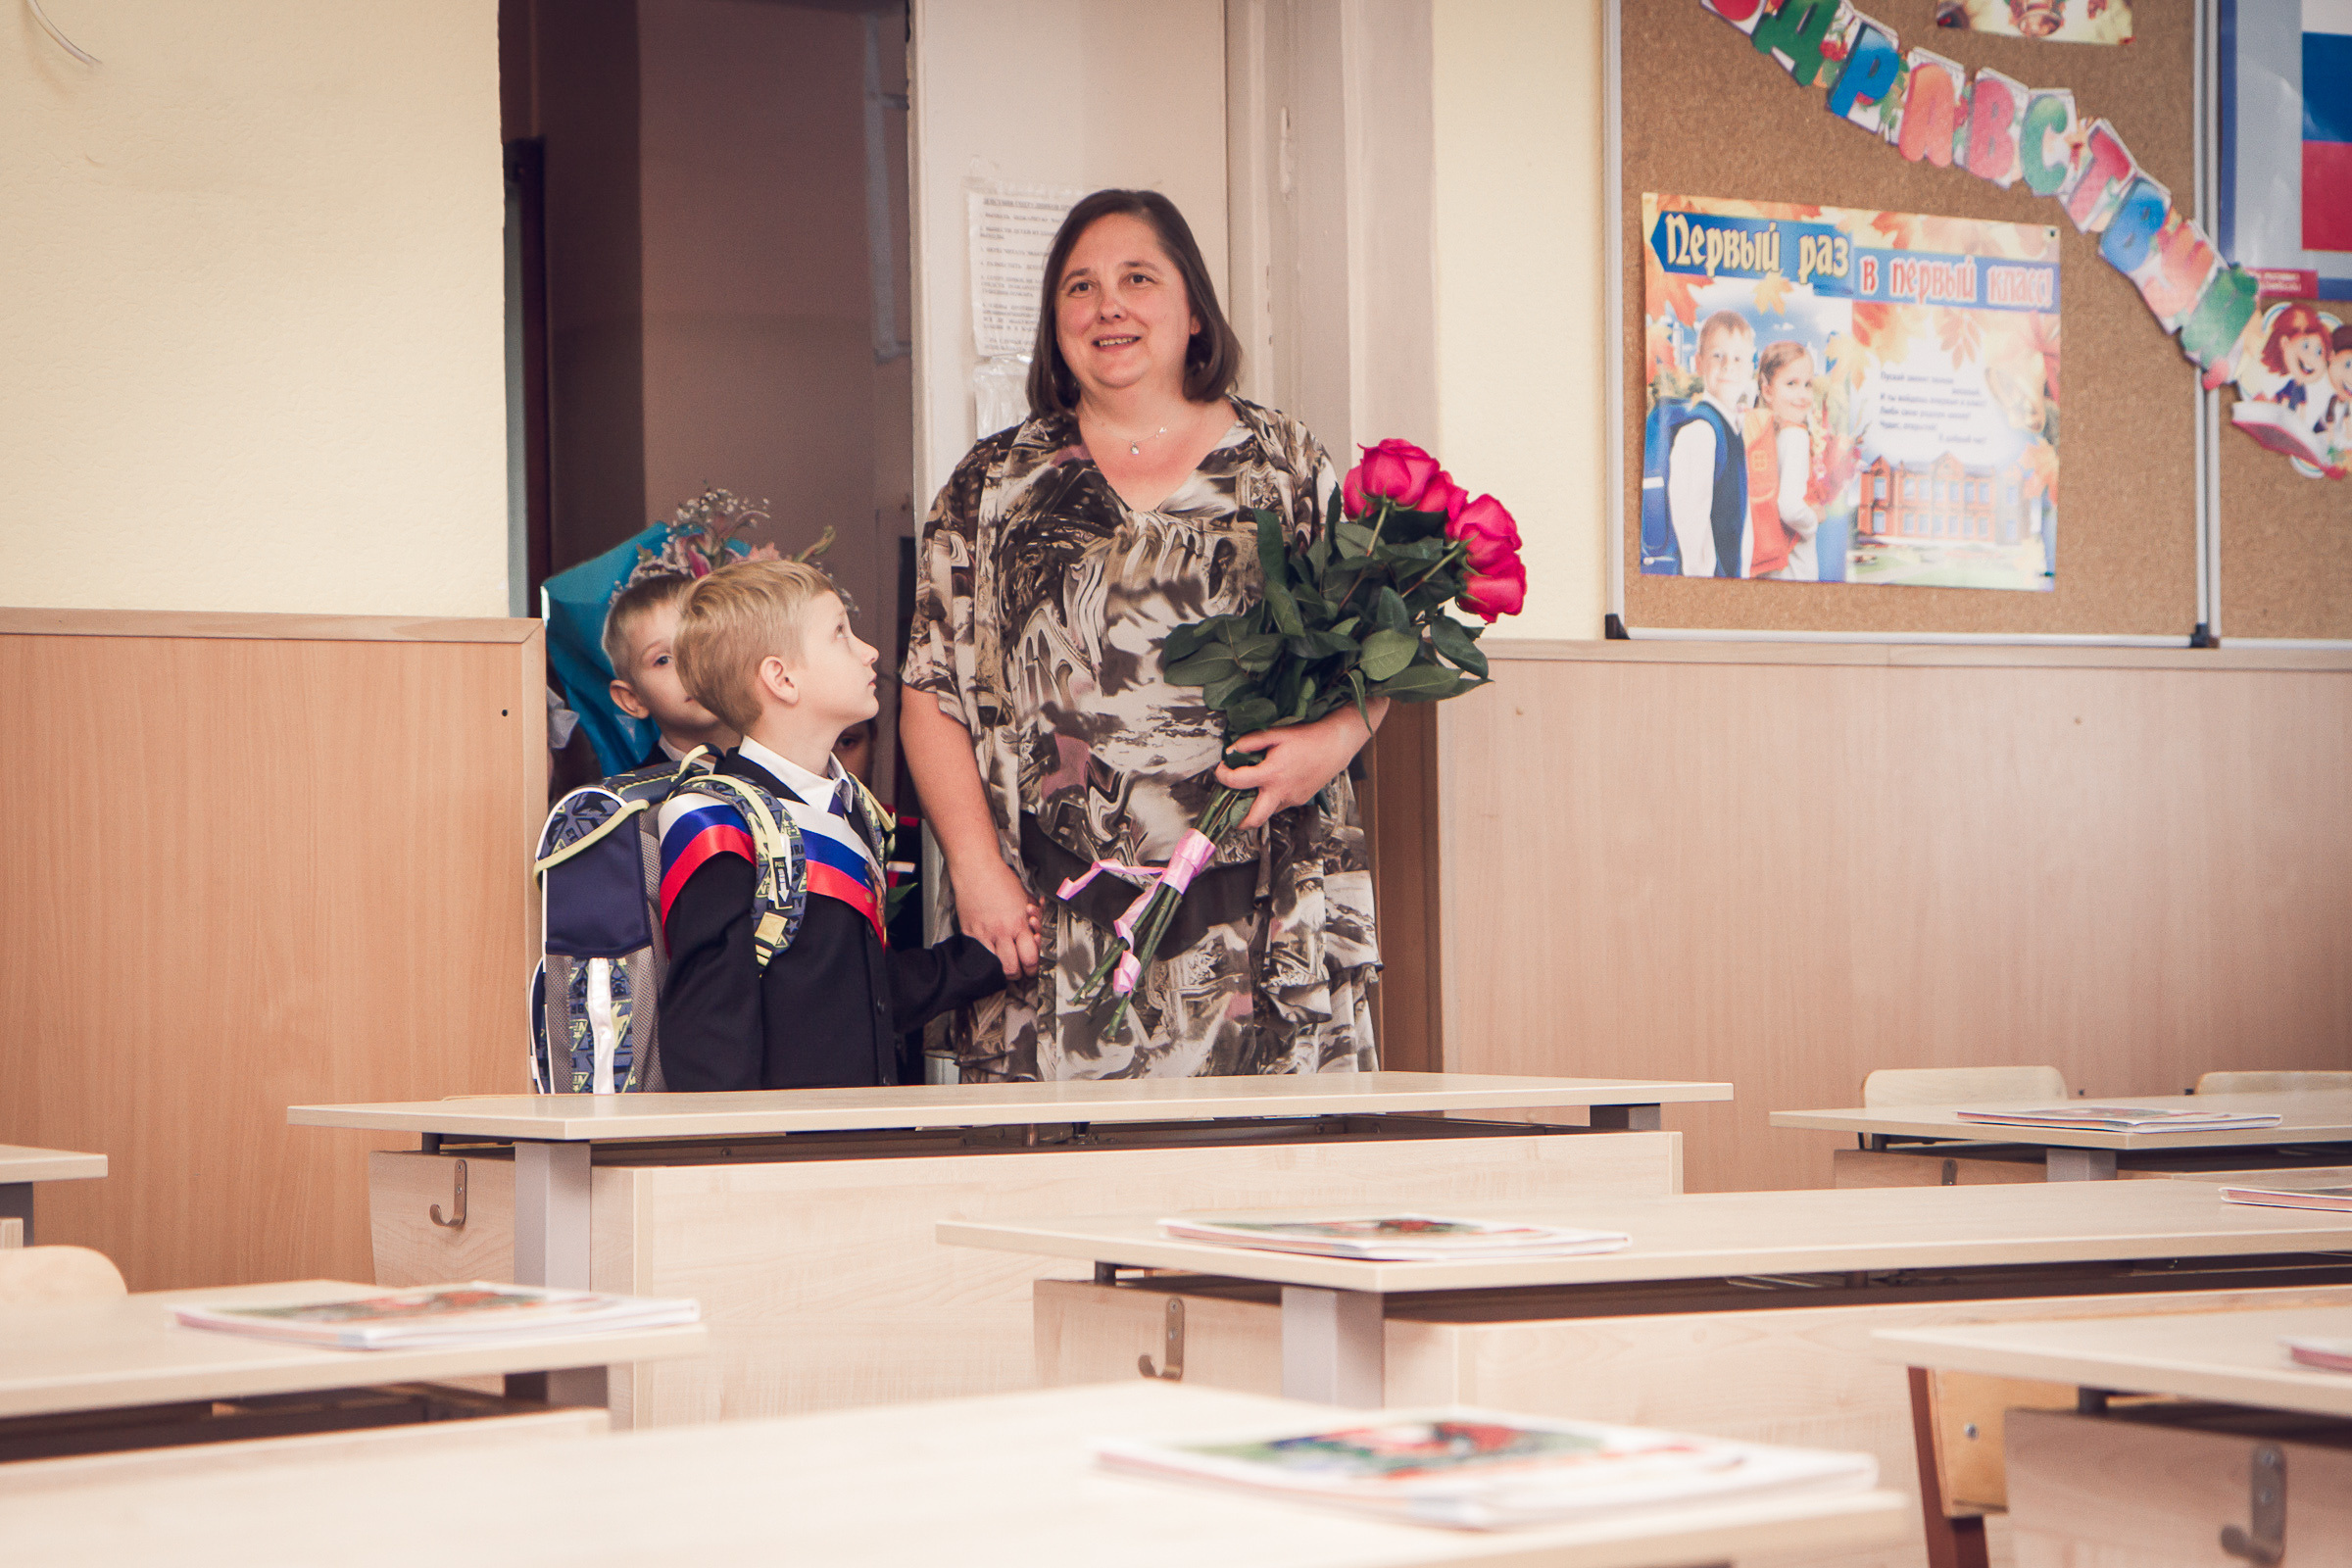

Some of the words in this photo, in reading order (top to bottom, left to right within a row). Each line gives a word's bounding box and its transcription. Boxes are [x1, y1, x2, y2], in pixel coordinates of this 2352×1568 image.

[1708, 0, 2258, 368] ДРАВСТВУЙ
[1665, 212, 1781, 278] Первый
[1797, 234, 1850, 285] раз
[1890, 256, 1977, 305] первый
[1988, 266, 2054, 308] класс!
